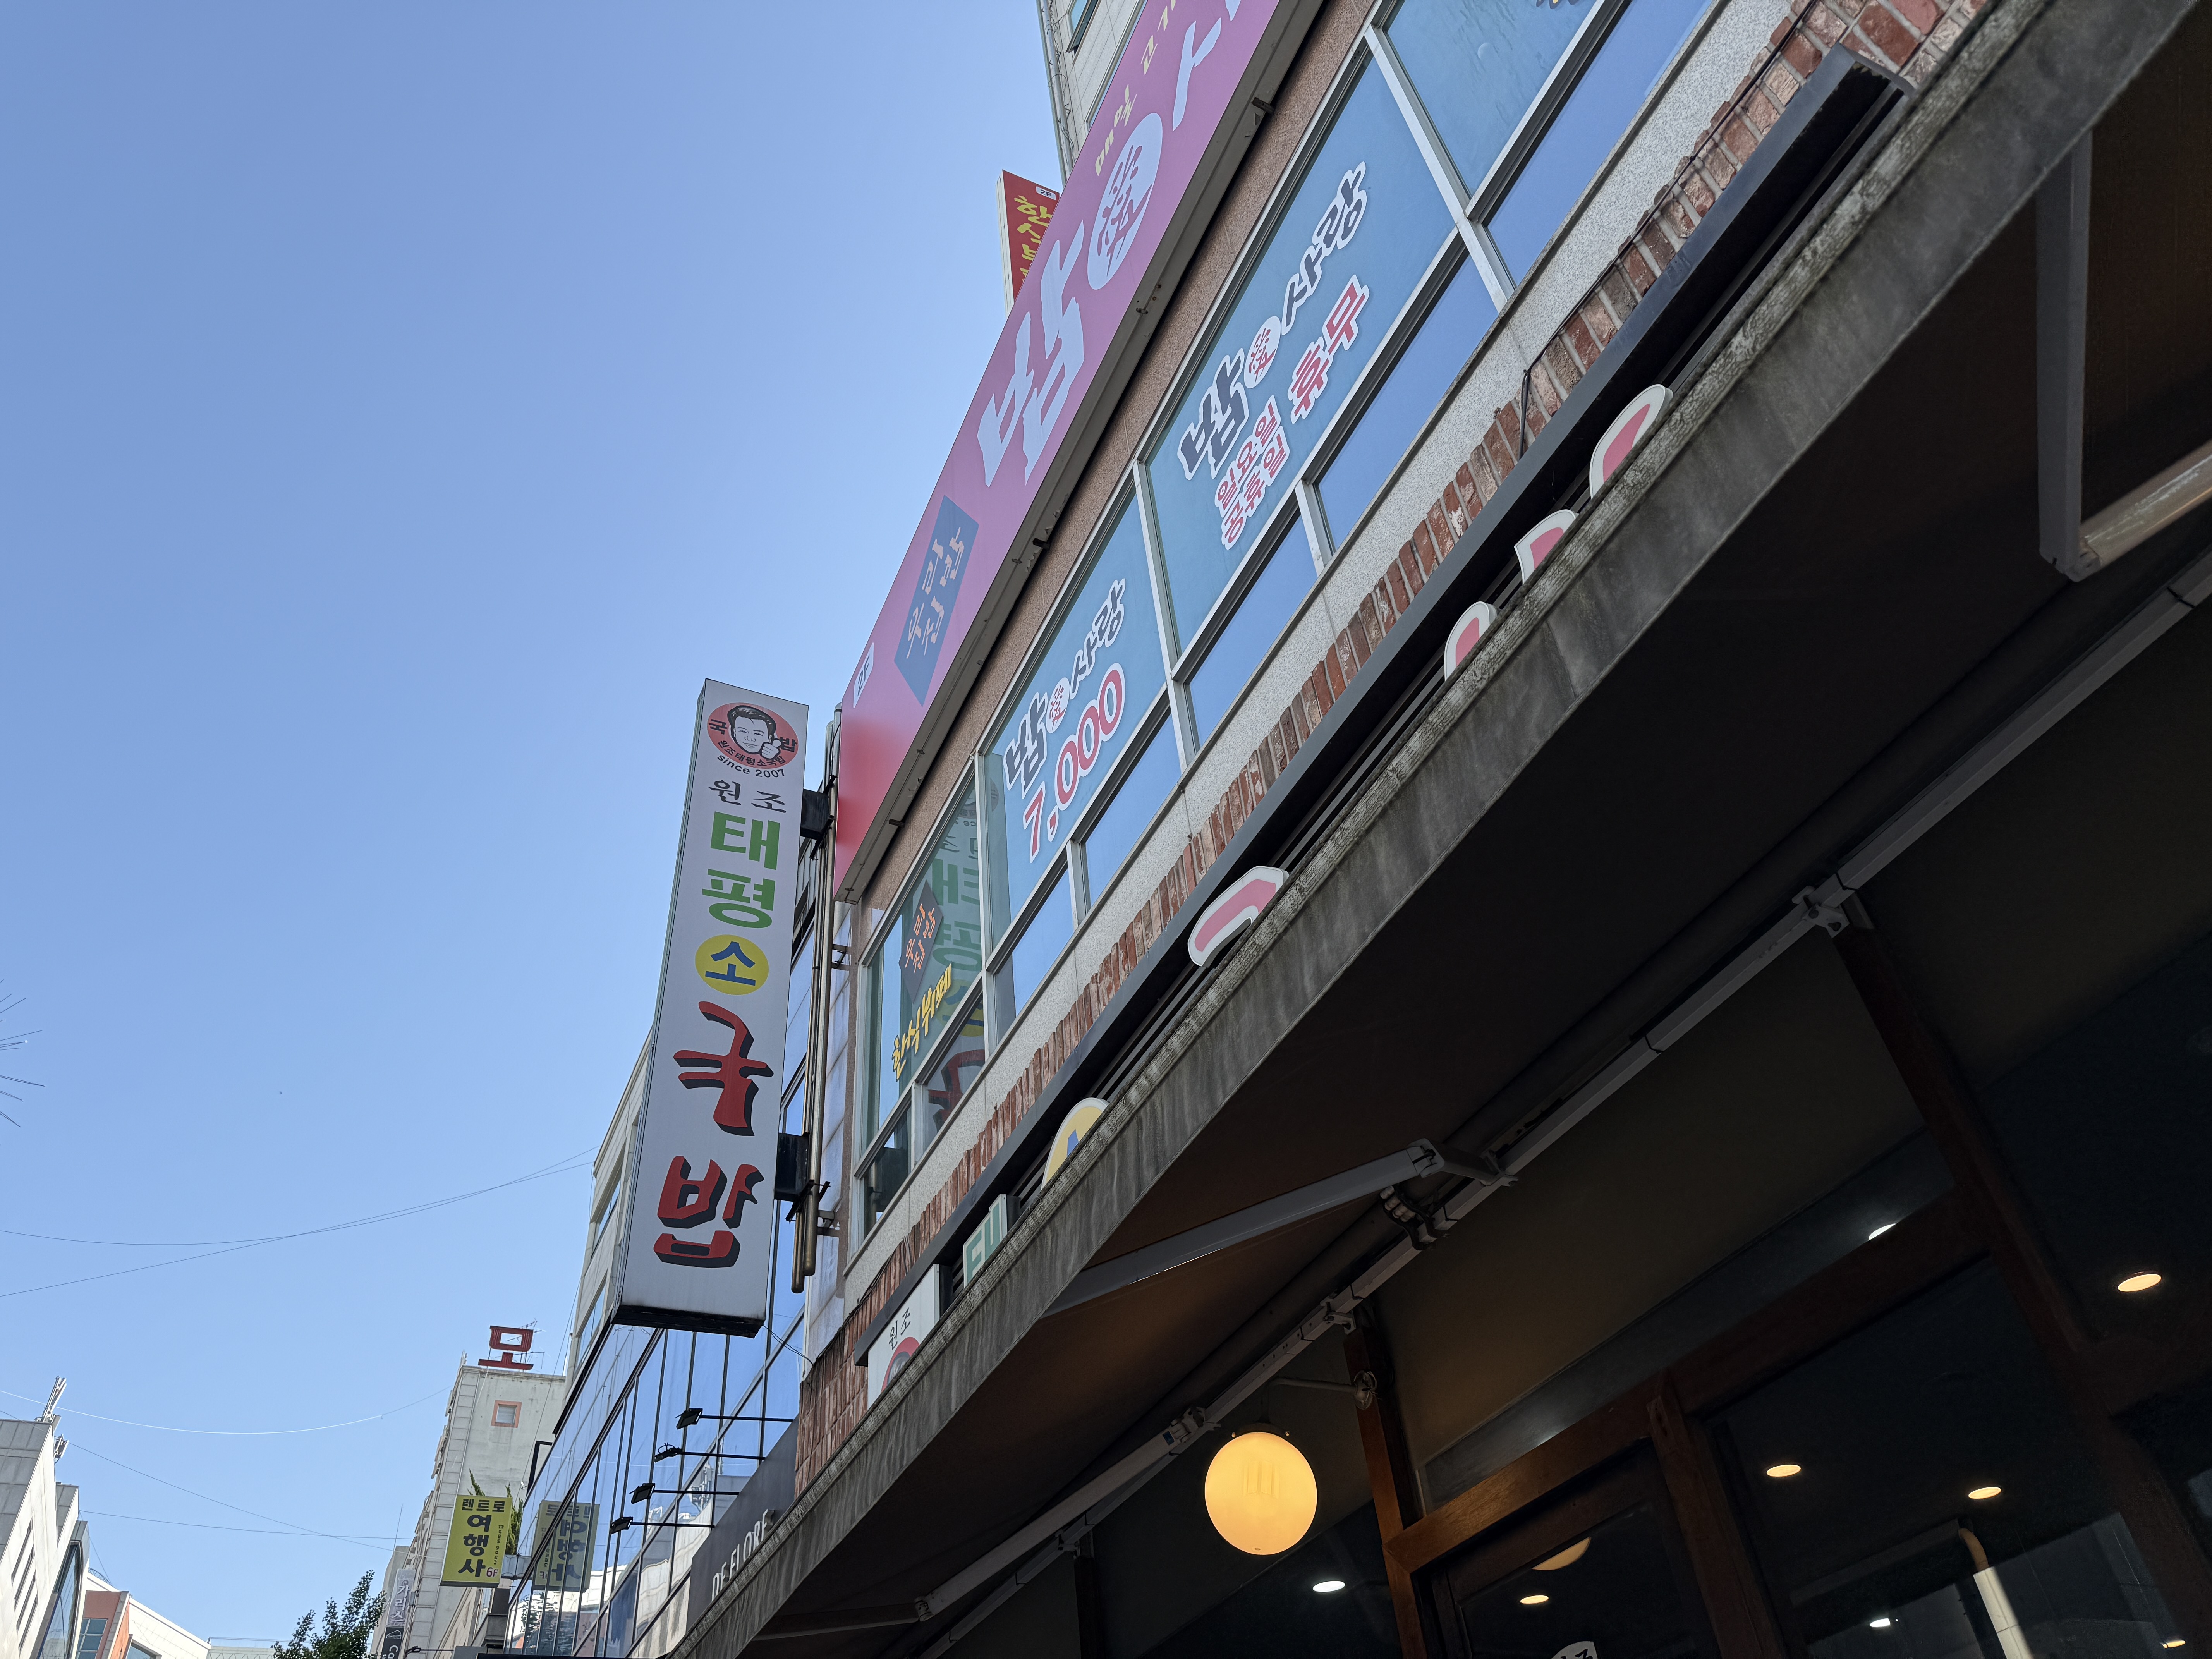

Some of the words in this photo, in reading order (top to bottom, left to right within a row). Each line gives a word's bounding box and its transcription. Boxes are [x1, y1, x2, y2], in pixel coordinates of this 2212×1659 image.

[1291, 282, 1366, 417] 휴무
[1217, 402, 1278, 512] 일요일
[1224, 433, 1287, 544] 공휴일
[857, 654, 870, 696] 2F
[717, 755, 750, 774] since
[756, 768, 785, 778] 2007
[1025, 669, 1123, 858] 7,000
[708, 779, 787, 813] 원조
[888, 1307, 911, 1350] 원조
[462, 1499, 505, 1513] 렌트로
[458, 1514, 492, 1577] 여행사
[486, 1567, 498, 1577] 6F
